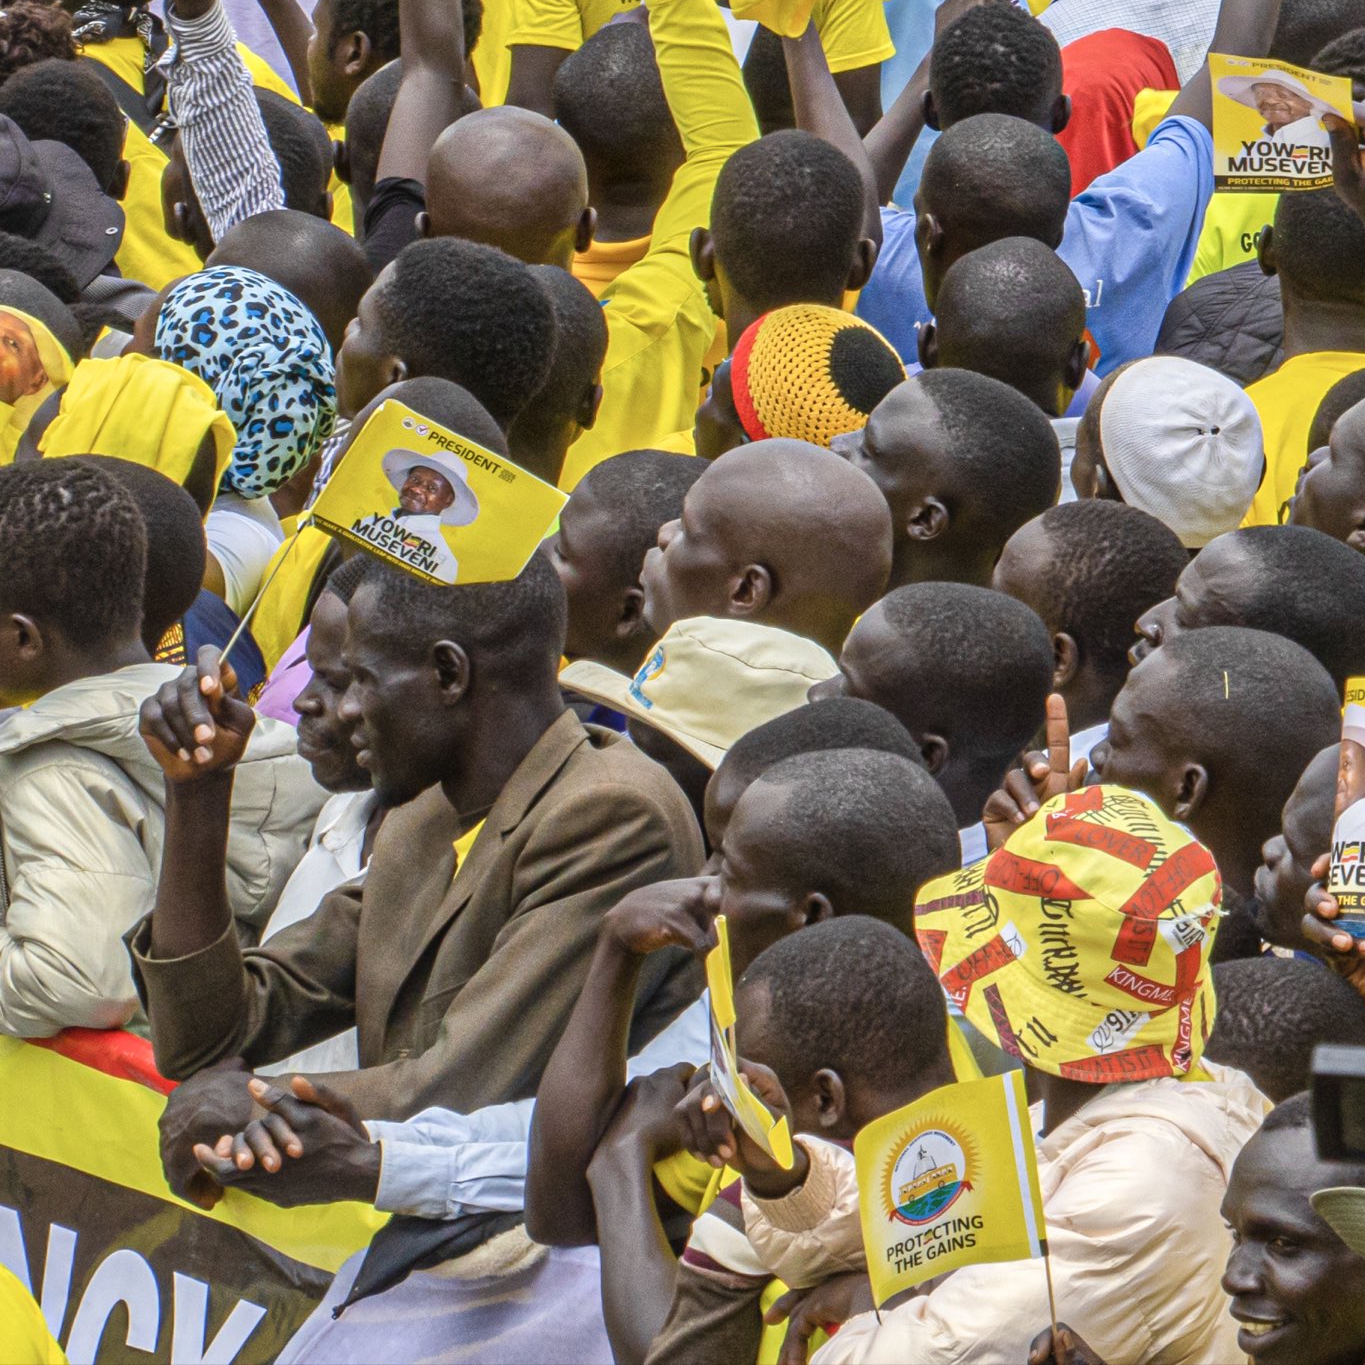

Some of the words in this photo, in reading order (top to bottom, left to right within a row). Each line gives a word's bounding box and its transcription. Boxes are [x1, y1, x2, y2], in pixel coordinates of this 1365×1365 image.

[1252, 62, 1316, 82] PRESIDENT
[1241, 140, 1330, 160] YOWERI
[1228, 177, 1290, 186] PROTECTING
[1293, 178, 1312, 186] THE
[427, 431, 501, 474] PRESIDENT
[351, 519, 439, 573] MUSEVENI
[371, 512, 437, 557] YOWERI
[1338, 895, 1358, 906] THE
[887, 1215, 983, 1262] PROTECTING
[895, 1251, 922, 1274] THE
[926, 1233, 976, 1260] GAINS
